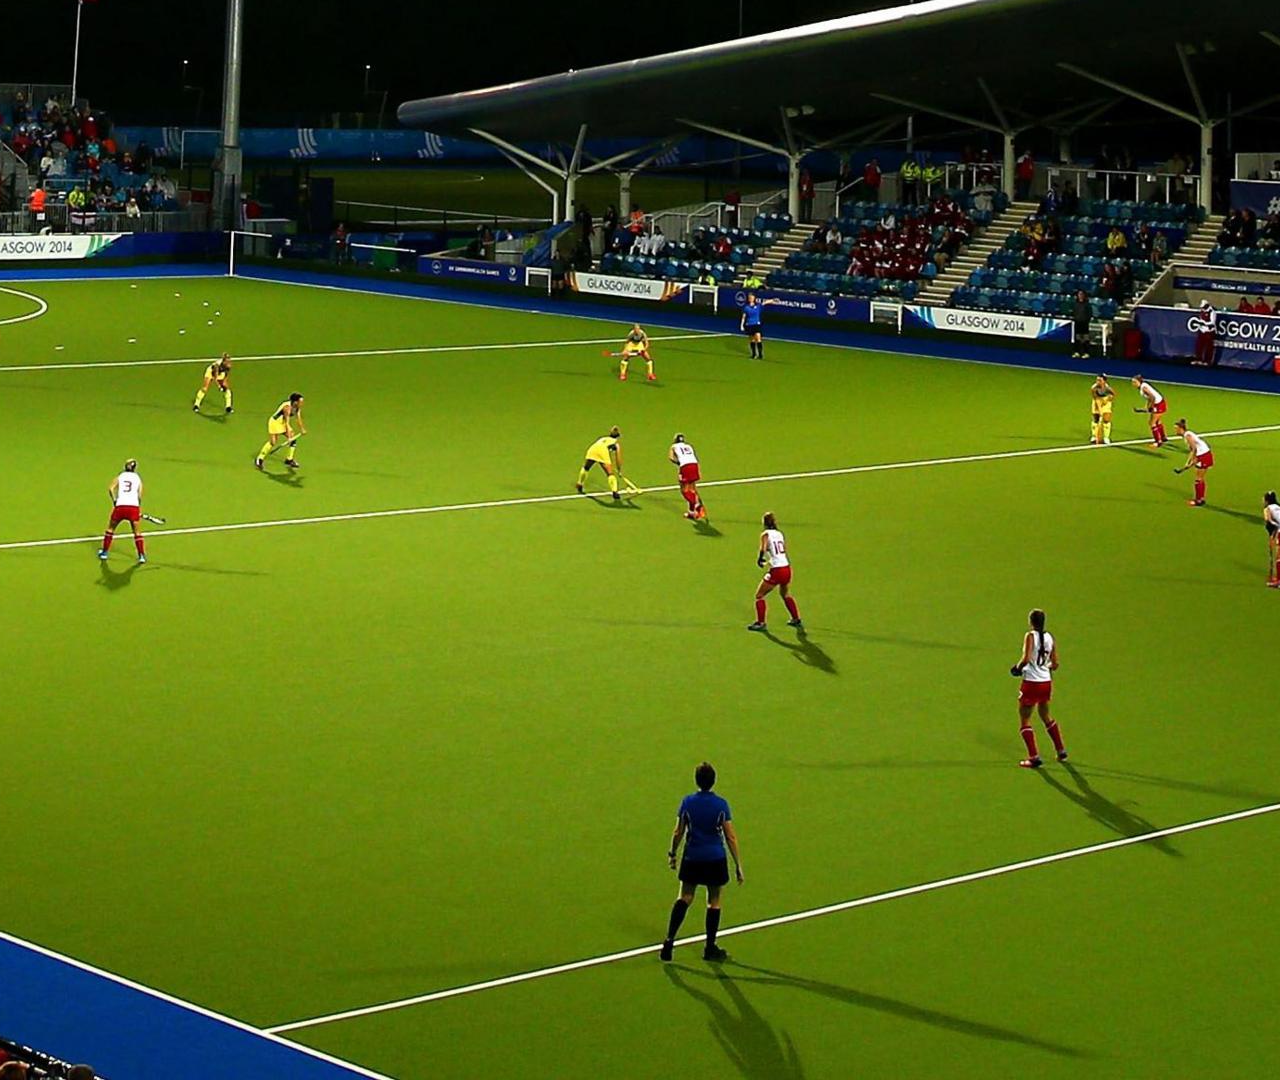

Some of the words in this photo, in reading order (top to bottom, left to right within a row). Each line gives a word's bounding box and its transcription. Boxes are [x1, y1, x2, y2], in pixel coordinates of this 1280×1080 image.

[49, 241, 73, 253] 2014
[587, 277, 631, 294] GLASGOW
[632, 282, 652, 294] 2014
[946, 313, 1001, 331] GLASGOW
[1004, 318, 1026, 333] 2014
[123, 480, 132, 493] 3
[773, 541, 785, 555] 10
